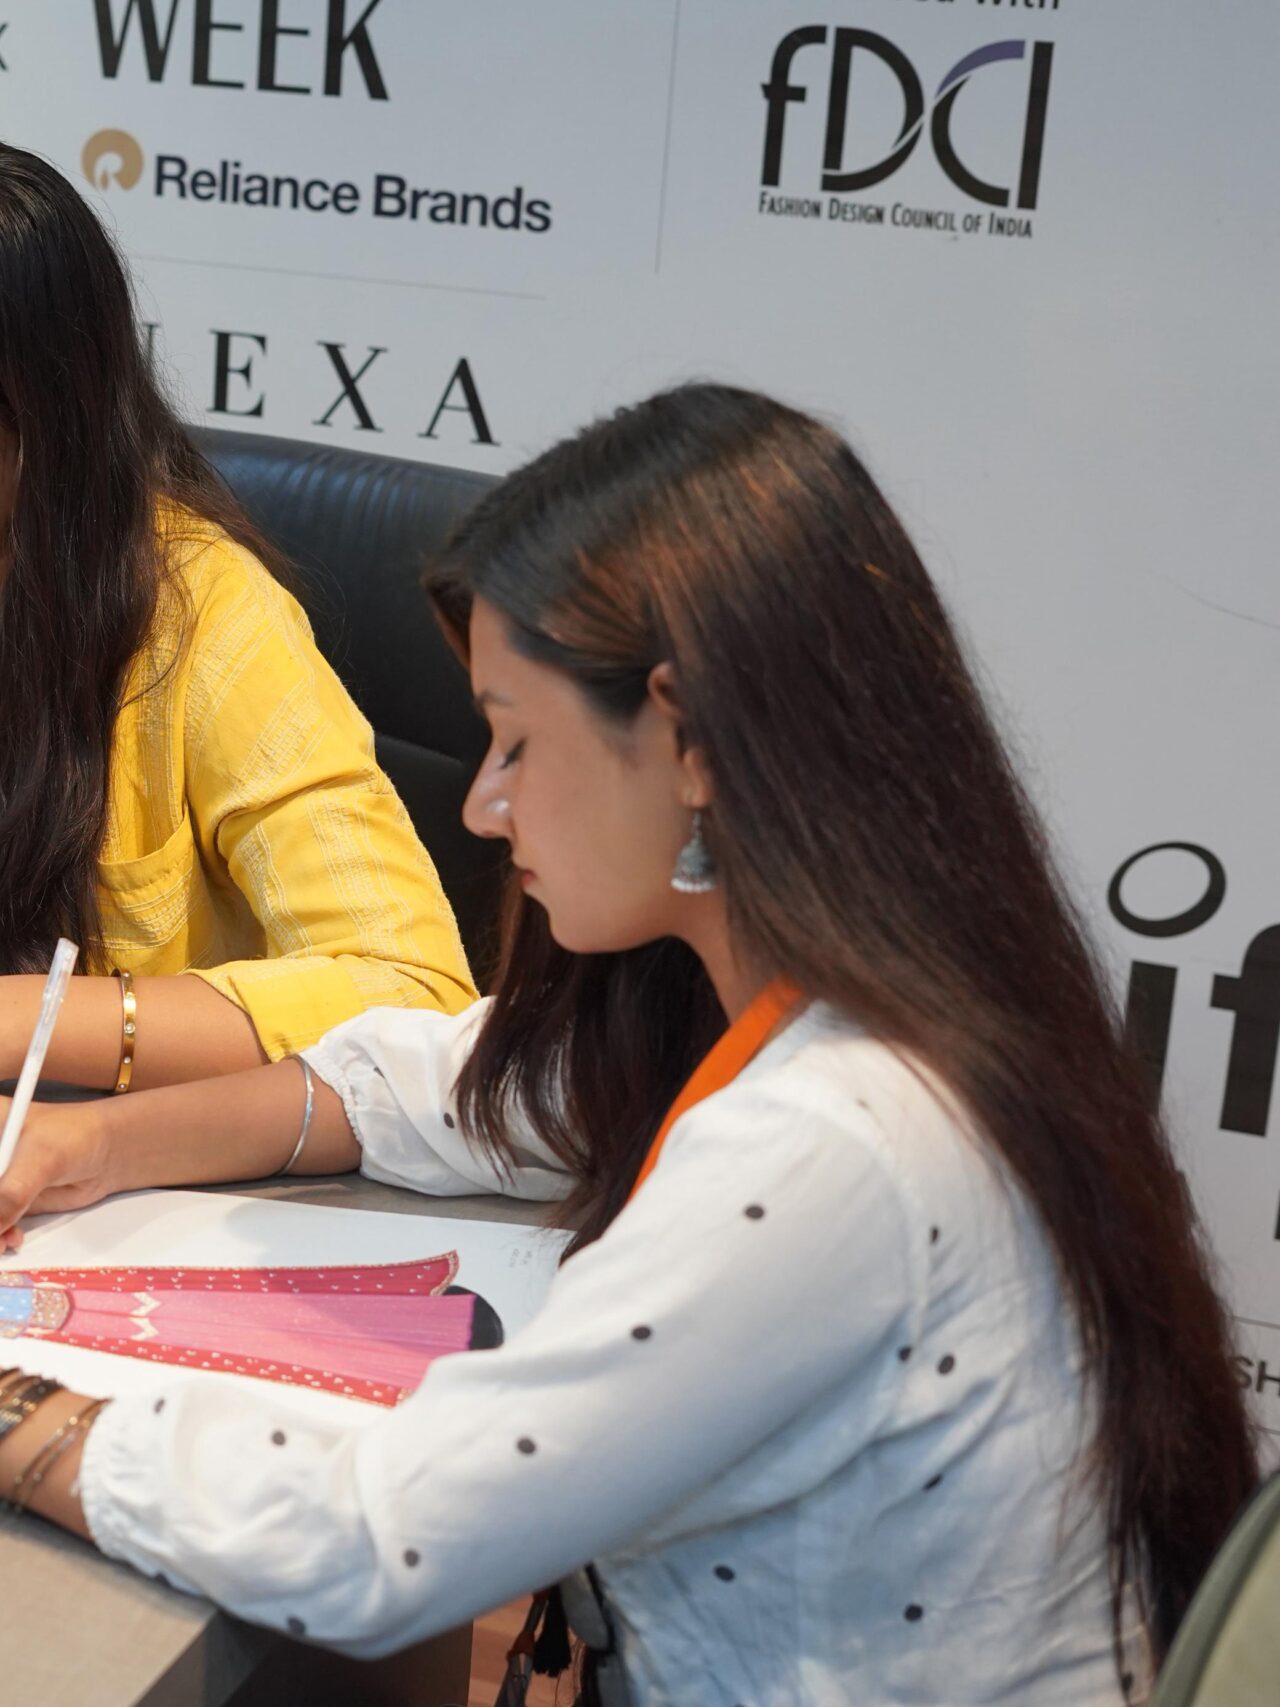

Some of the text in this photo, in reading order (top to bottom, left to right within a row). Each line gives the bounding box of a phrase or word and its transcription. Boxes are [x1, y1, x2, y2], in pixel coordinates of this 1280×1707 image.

[93, 0, 390, 102] WEEK
[154, 155, 553, 234] Reliance Brands
[759, 191, 821, 218] FASHION
[828, 198, 885, 225] DESIGN
[891, 204, 956, 231] COUNCIL
[987, 212, 1033, 238] INDIA
[142, 322, 501, 446] EXA
[1108, 841, 1280, 1137] if
